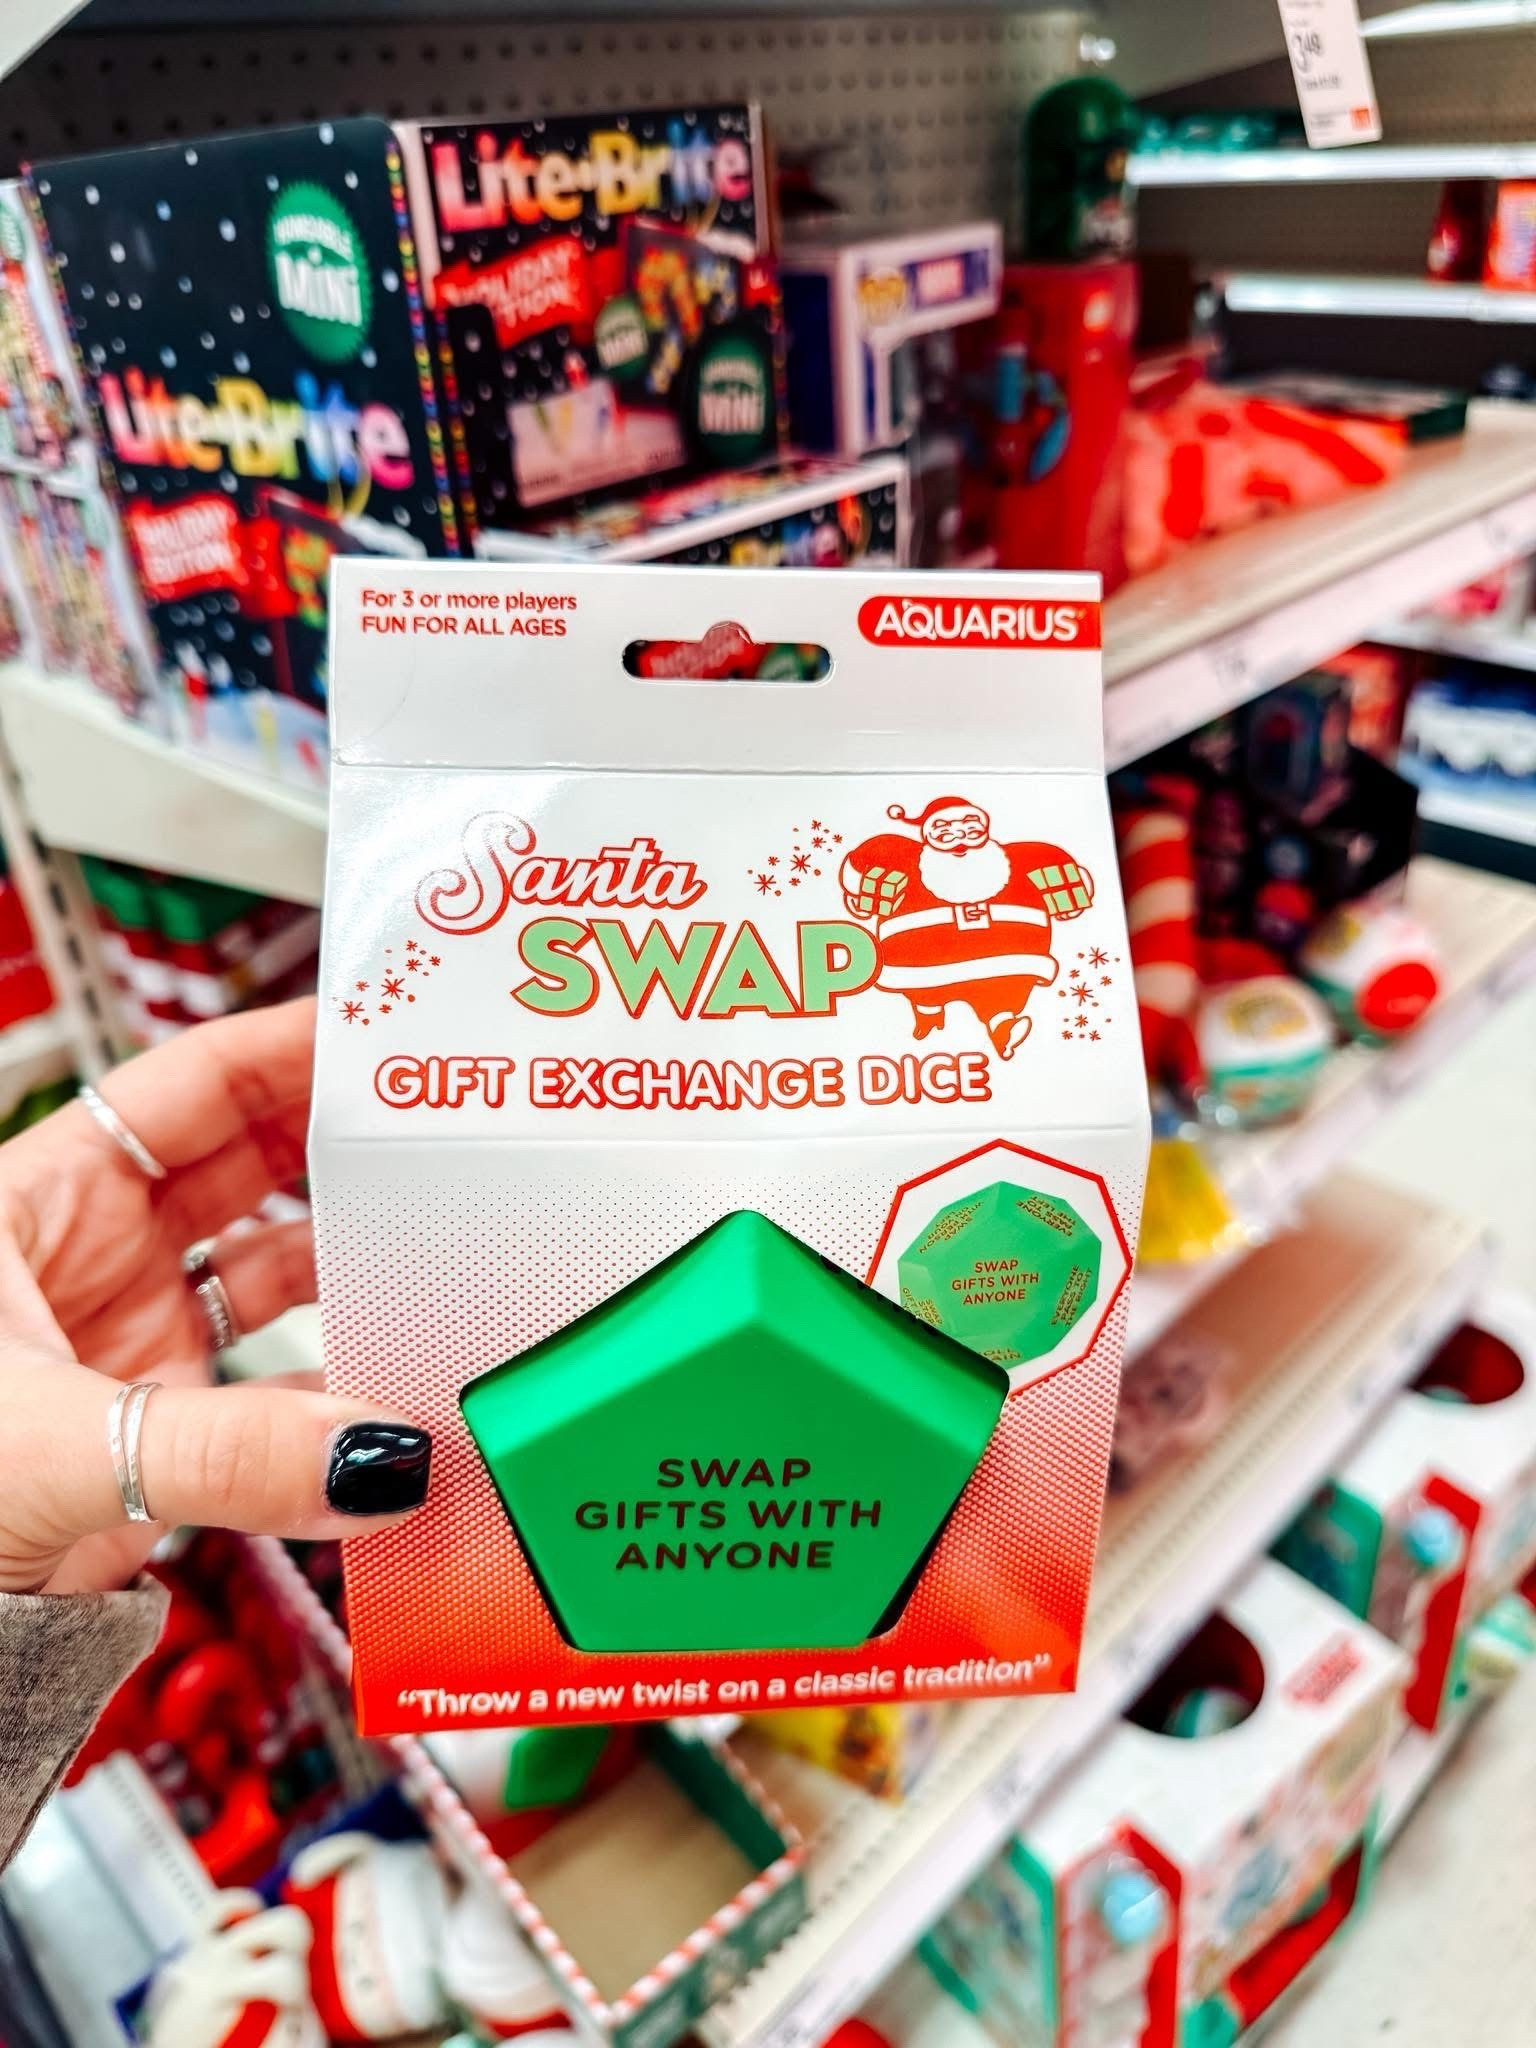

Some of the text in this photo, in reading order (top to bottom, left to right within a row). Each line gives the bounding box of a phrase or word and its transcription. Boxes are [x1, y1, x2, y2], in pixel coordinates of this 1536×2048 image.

[361, 589, 577, 613] For 3 or more players
[362, 616, 567, 637] FUN FOR ALL AGES
[413, 810, 709, 936] Santa
[509, 917, 883, 1020] SWAP
[374, 1052, 995, 1110] GIFT EXCHANGE DICE
[1015, 1199, 1072, 1237] EVERYONE
[975, 1259, 1018, 1273] SWAP
[952, 1273, 1039, 1291] GIFTS WITH
[963, 1288, 1026, 1305] ANYONE
[657, 1458, 811, 1488] SWAP
[575, 1500, 881, 1529] GIFTS WITH
[615, 1541, 834, 1570] ANYONE
[528, 1690, 547, 1711] a
[556, 1687, 625, 1711] new
[633, 1679, 709, 1706] twist
[718, 1679, 758, 1700] on
[767, 1677, 786, 1698] a
[794, 1666, 895, 1699] classic
